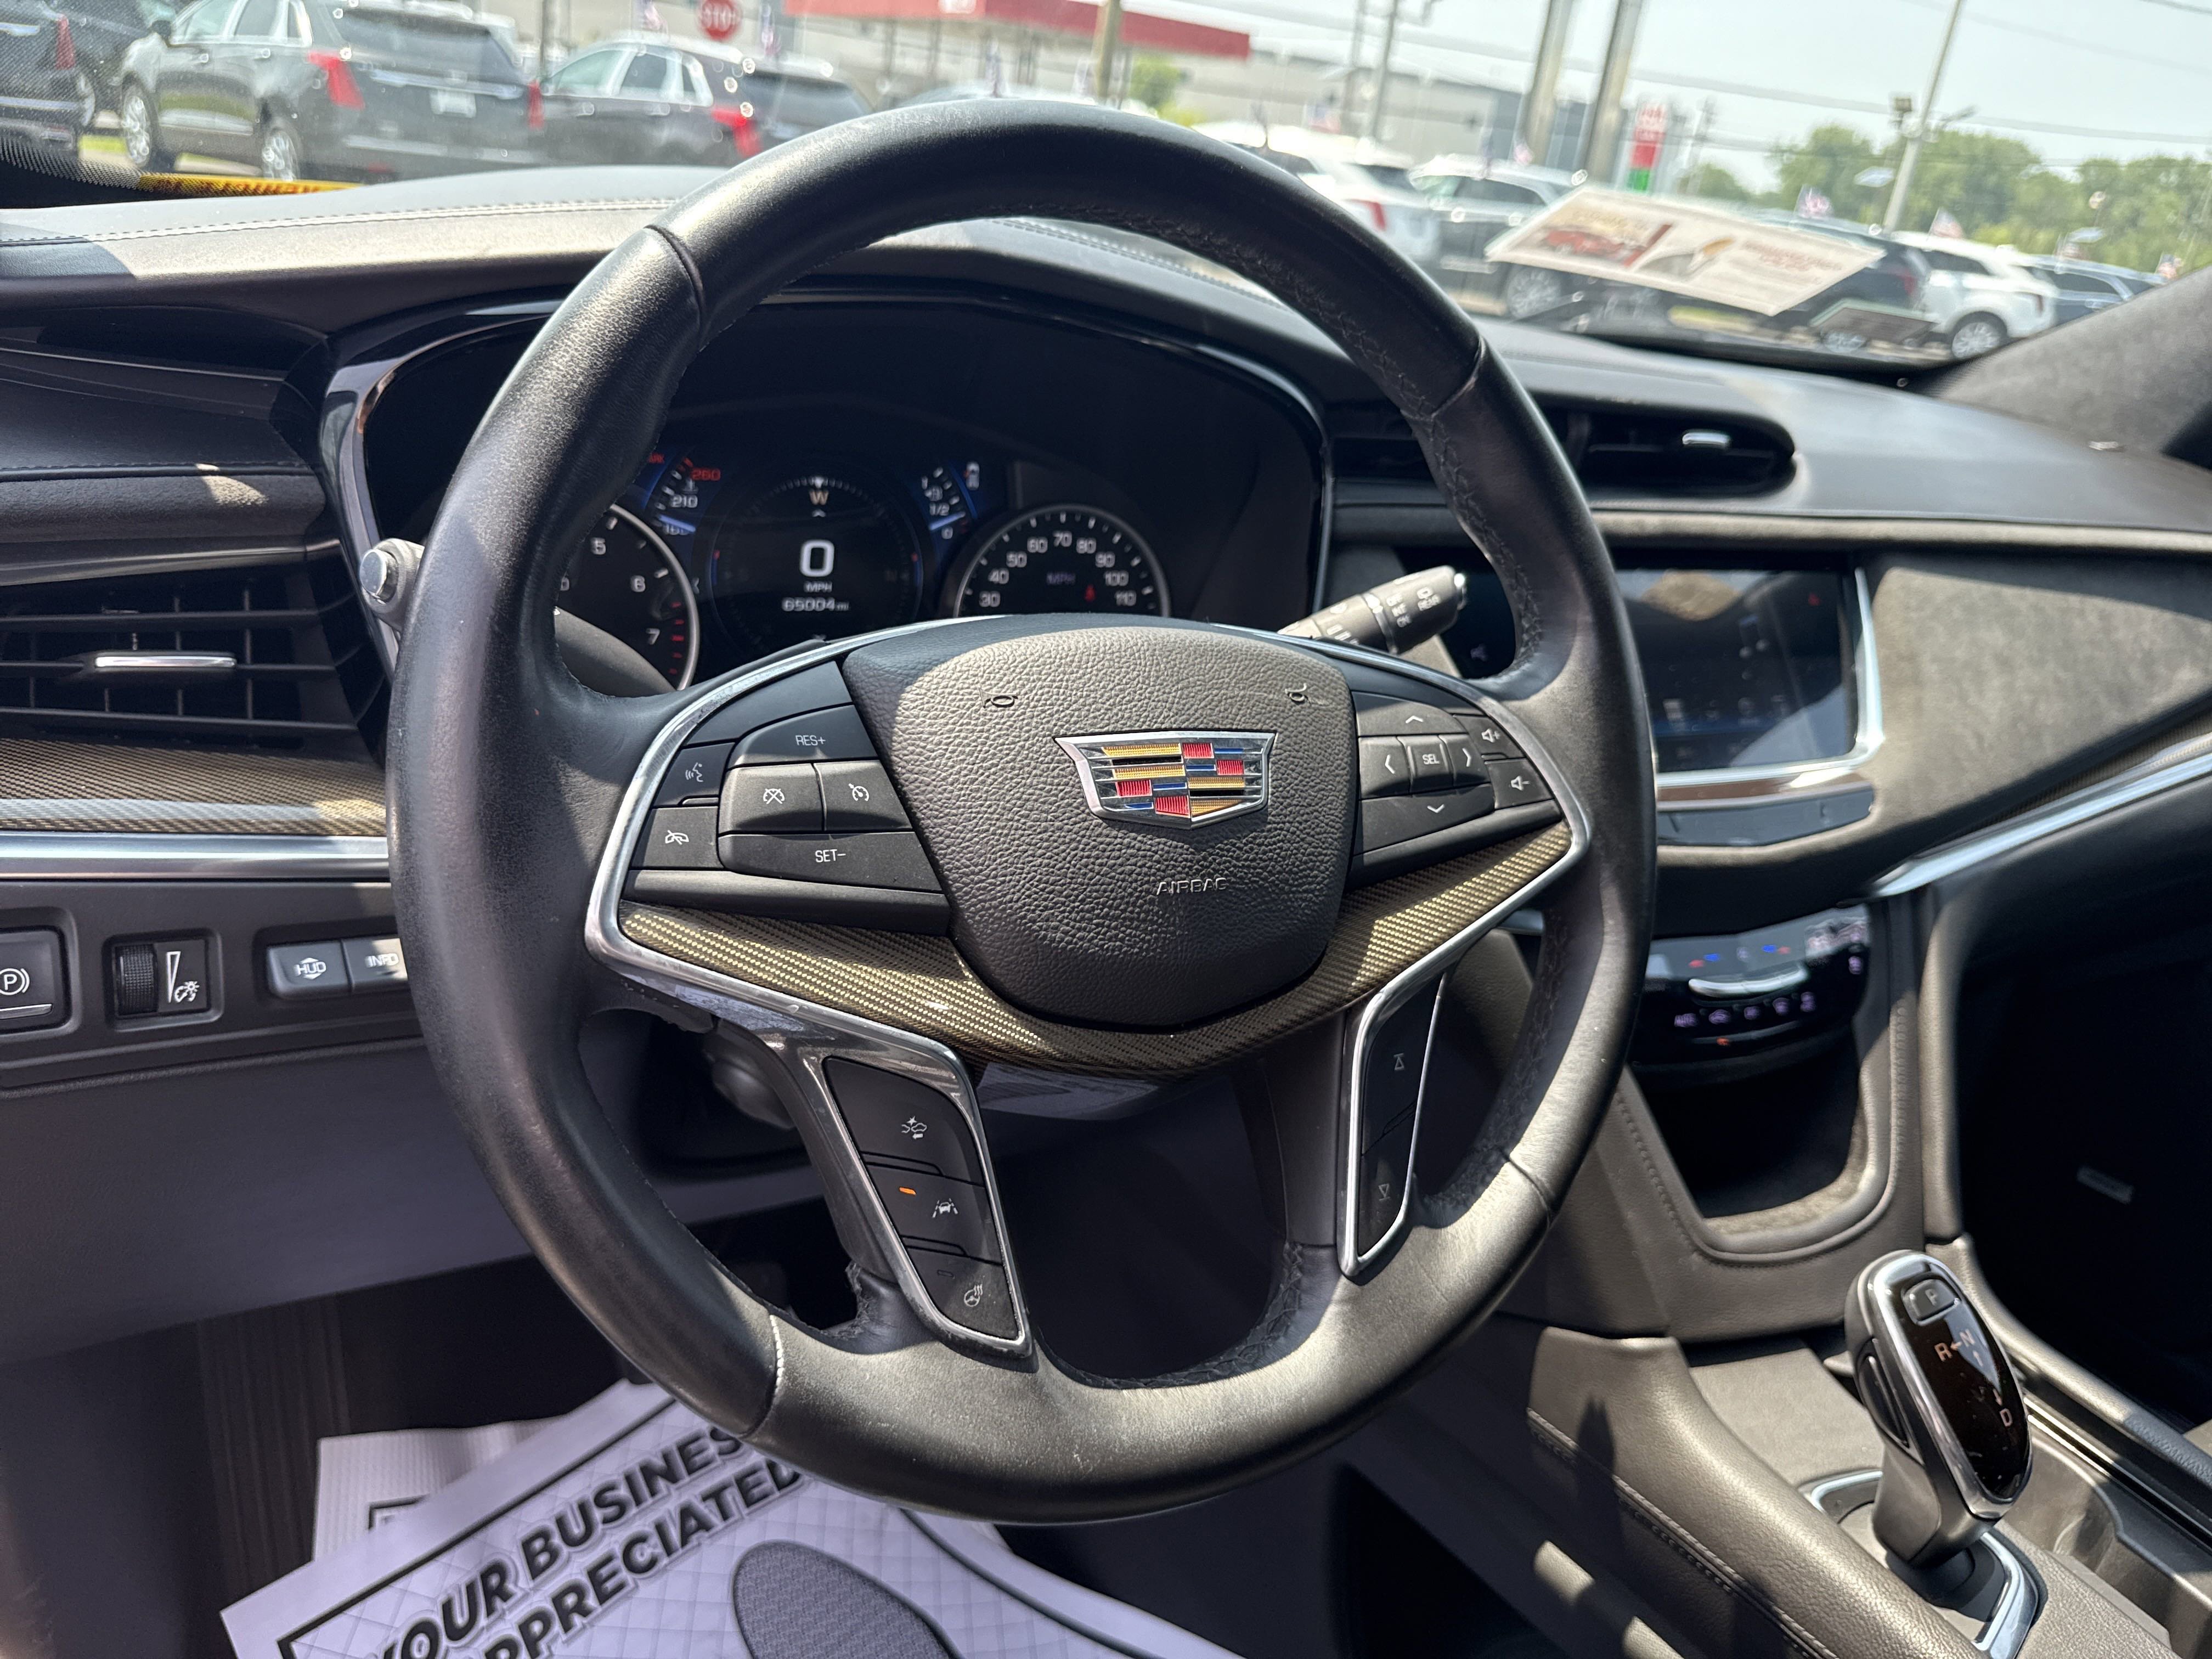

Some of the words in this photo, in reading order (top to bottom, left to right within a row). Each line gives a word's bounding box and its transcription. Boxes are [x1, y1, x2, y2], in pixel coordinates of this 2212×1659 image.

[670, 495, 698, 508] 210
[809, 489, 829, 505] W
[590, 537, 606, 555] 5
[1027, 537, 1048, 553] 60
[1053, 531, 1072, 547] 70
[1076, 538, 1096, 554] 80
[799, 539, 834, 577] 0
[1006, 552, 1027, 567] 50
[1096, 552, 1115, 568] 90
[631, 575, 646, 592] 6
[989, 568, 1009, 584] 40
[1104, 570, 1129, 586] 100
[804, 581, 832, 592] MPH
[979, 591, 1000, 607] 30
[1115, 590, 1137, 606] 110
[646, 628, 661, 645] 7
[795, 734, 826, 747] RES+
[1423, 754, 1440, 765] SEL
[815, 849, 846, 864] SET-
[294, 961, 326, 976] HUD
[365, 953, 399, 968] INFO
[1959, 1328, 1976, 1347] N
[1934, 1342, 1953, 1362] R
[2000, 1408, 2013, 1427] D
[384, 1562, 515, 1659] OUR
[520, 1426, 743, 1581] BUSINES
[485, 1458, 802, 1659] PPRECIATED
